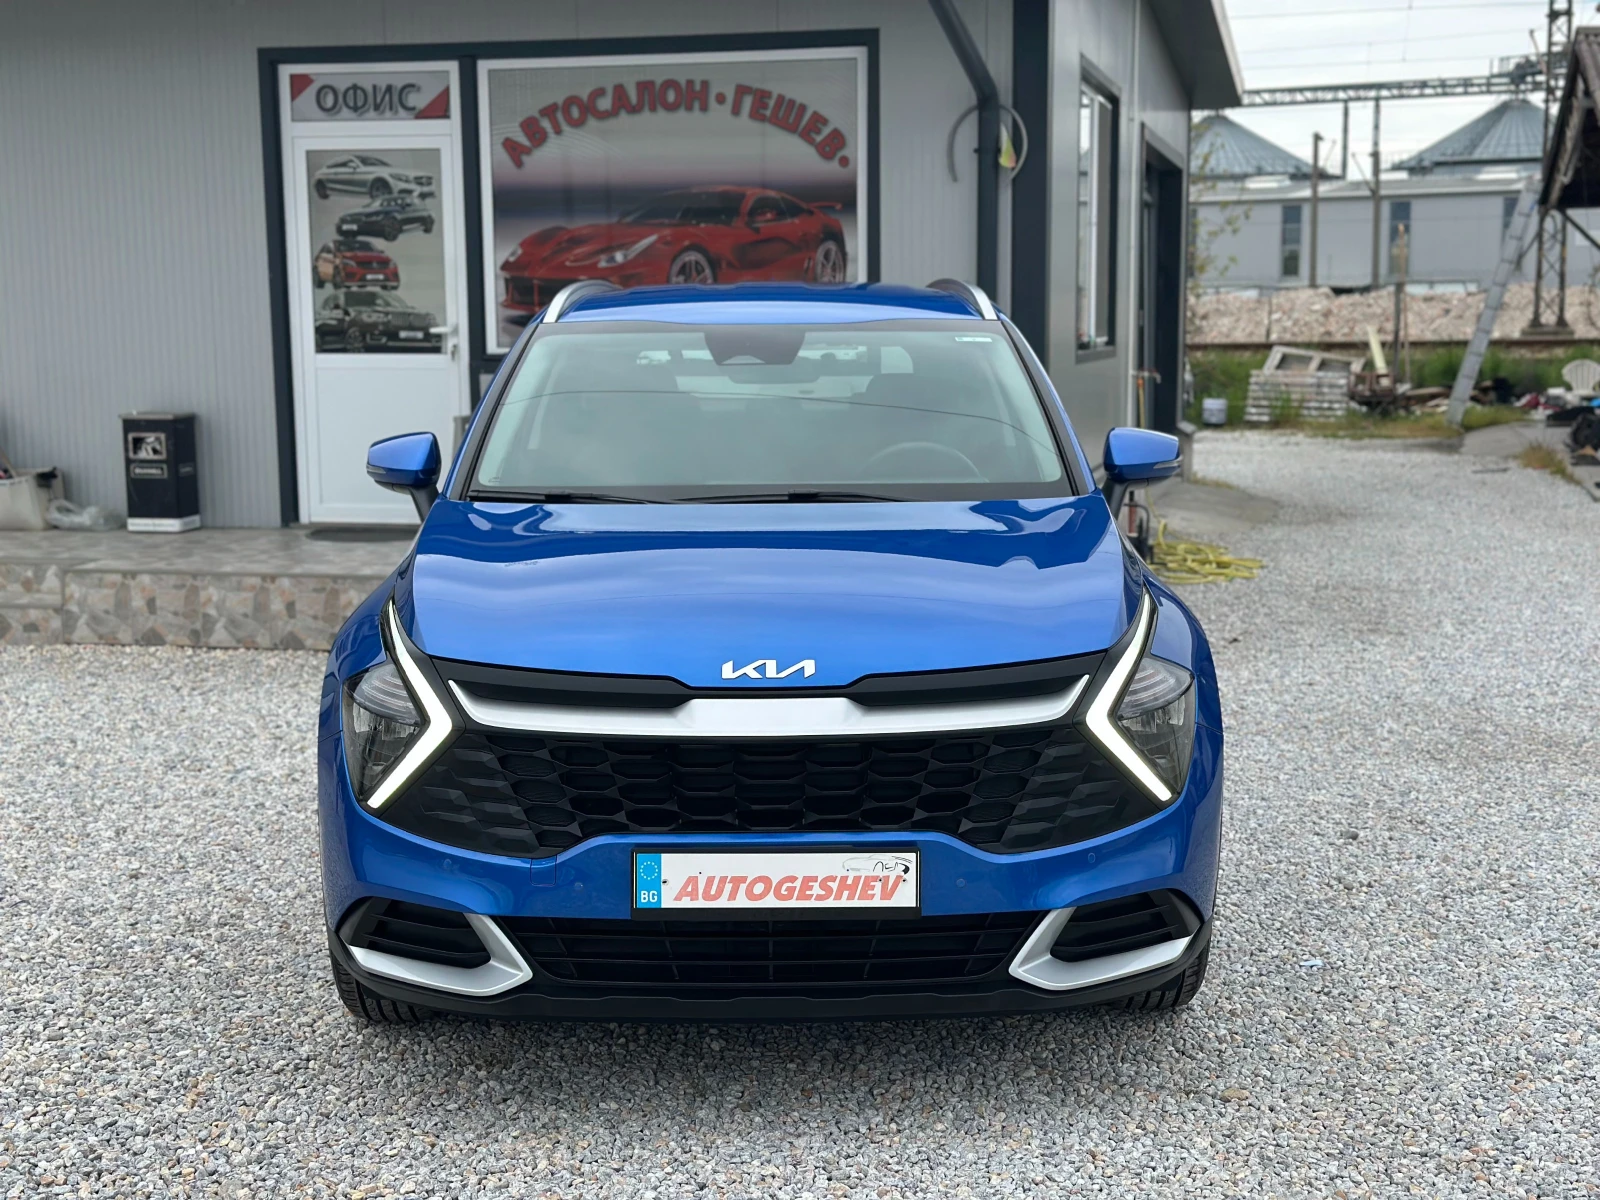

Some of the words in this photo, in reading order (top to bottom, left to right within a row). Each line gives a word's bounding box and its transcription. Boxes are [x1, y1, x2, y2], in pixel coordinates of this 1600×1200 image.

[315, 82, 419, 114] ОФИС
[721, 658, 816, 679] KIA
[640, 890, 658, 903] BG
[672, 874, 905, 902] AUTOGESHEV
